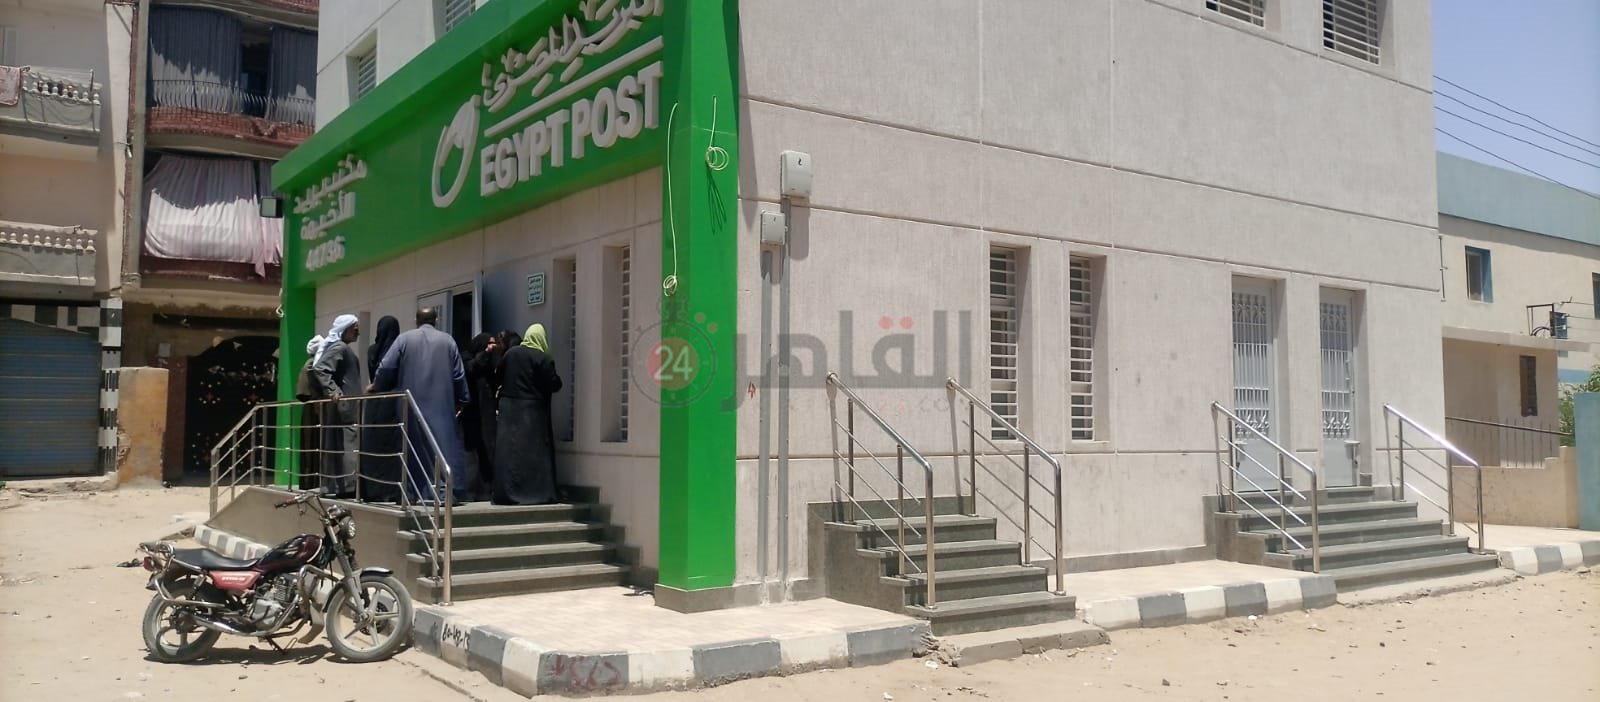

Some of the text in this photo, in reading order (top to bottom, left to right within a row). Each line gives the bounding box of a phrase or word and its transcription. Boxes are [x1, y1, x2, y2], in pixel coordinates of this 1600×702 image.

[480, 60, 664, 196] EGYPT POST
[293, 154, 368, 214] مكتب بريد
